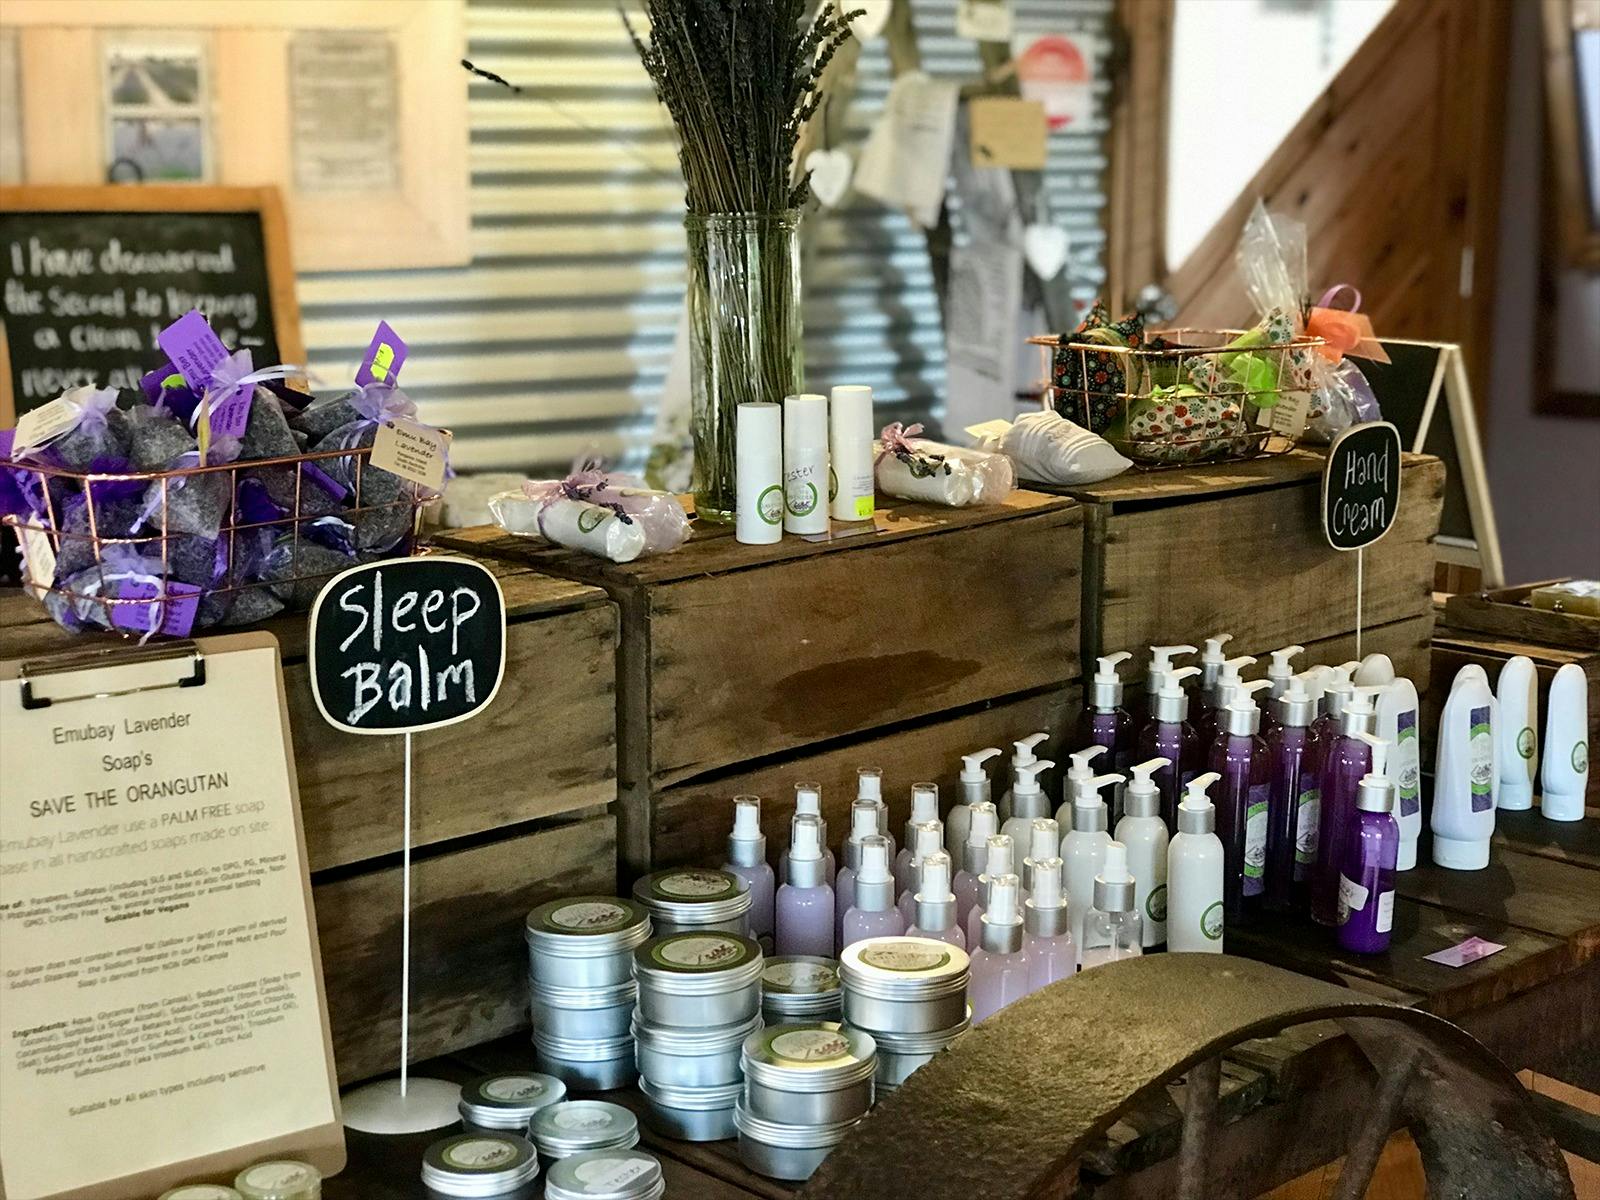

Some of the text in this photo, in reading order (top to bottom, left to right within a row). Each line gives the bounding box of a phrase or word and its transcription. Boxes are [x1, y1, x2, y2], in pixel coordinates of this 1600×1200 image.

[11, 241, 25, 275] I
[29, 236, 95, 278] have
[394, 440, 434, 458] Lavender
[1344, 438, 1389, 494] Hand
[1332, 496, 1386, 536] Cream
[339, 570, 481, 656] Sleep
[340, 643, 476, 726] Balm
[53, 711, 191, 745] Emubay Lavender
[102, 750, 153, 773] Soap's
[30, 771, 229, 818] SAVE THE ORANGUTAN
[58, 824, 120, 844] Lavender
[124, 820, 147, 833] use
[161, 808, 198, 826] PALM
[201, 803, 232, 820] FREE
[235, 800, 265, 815] soap
[67, 840, 148, 865] handcrafted
[190, 828, 225, 843] made
[104, 901, 190, 923] Suitable for Vegans
[69, 1100, 108, 1117] Suitable
[186, 1073, 226, 1089] including
[228, 1062, 267, 1079] sensitive
